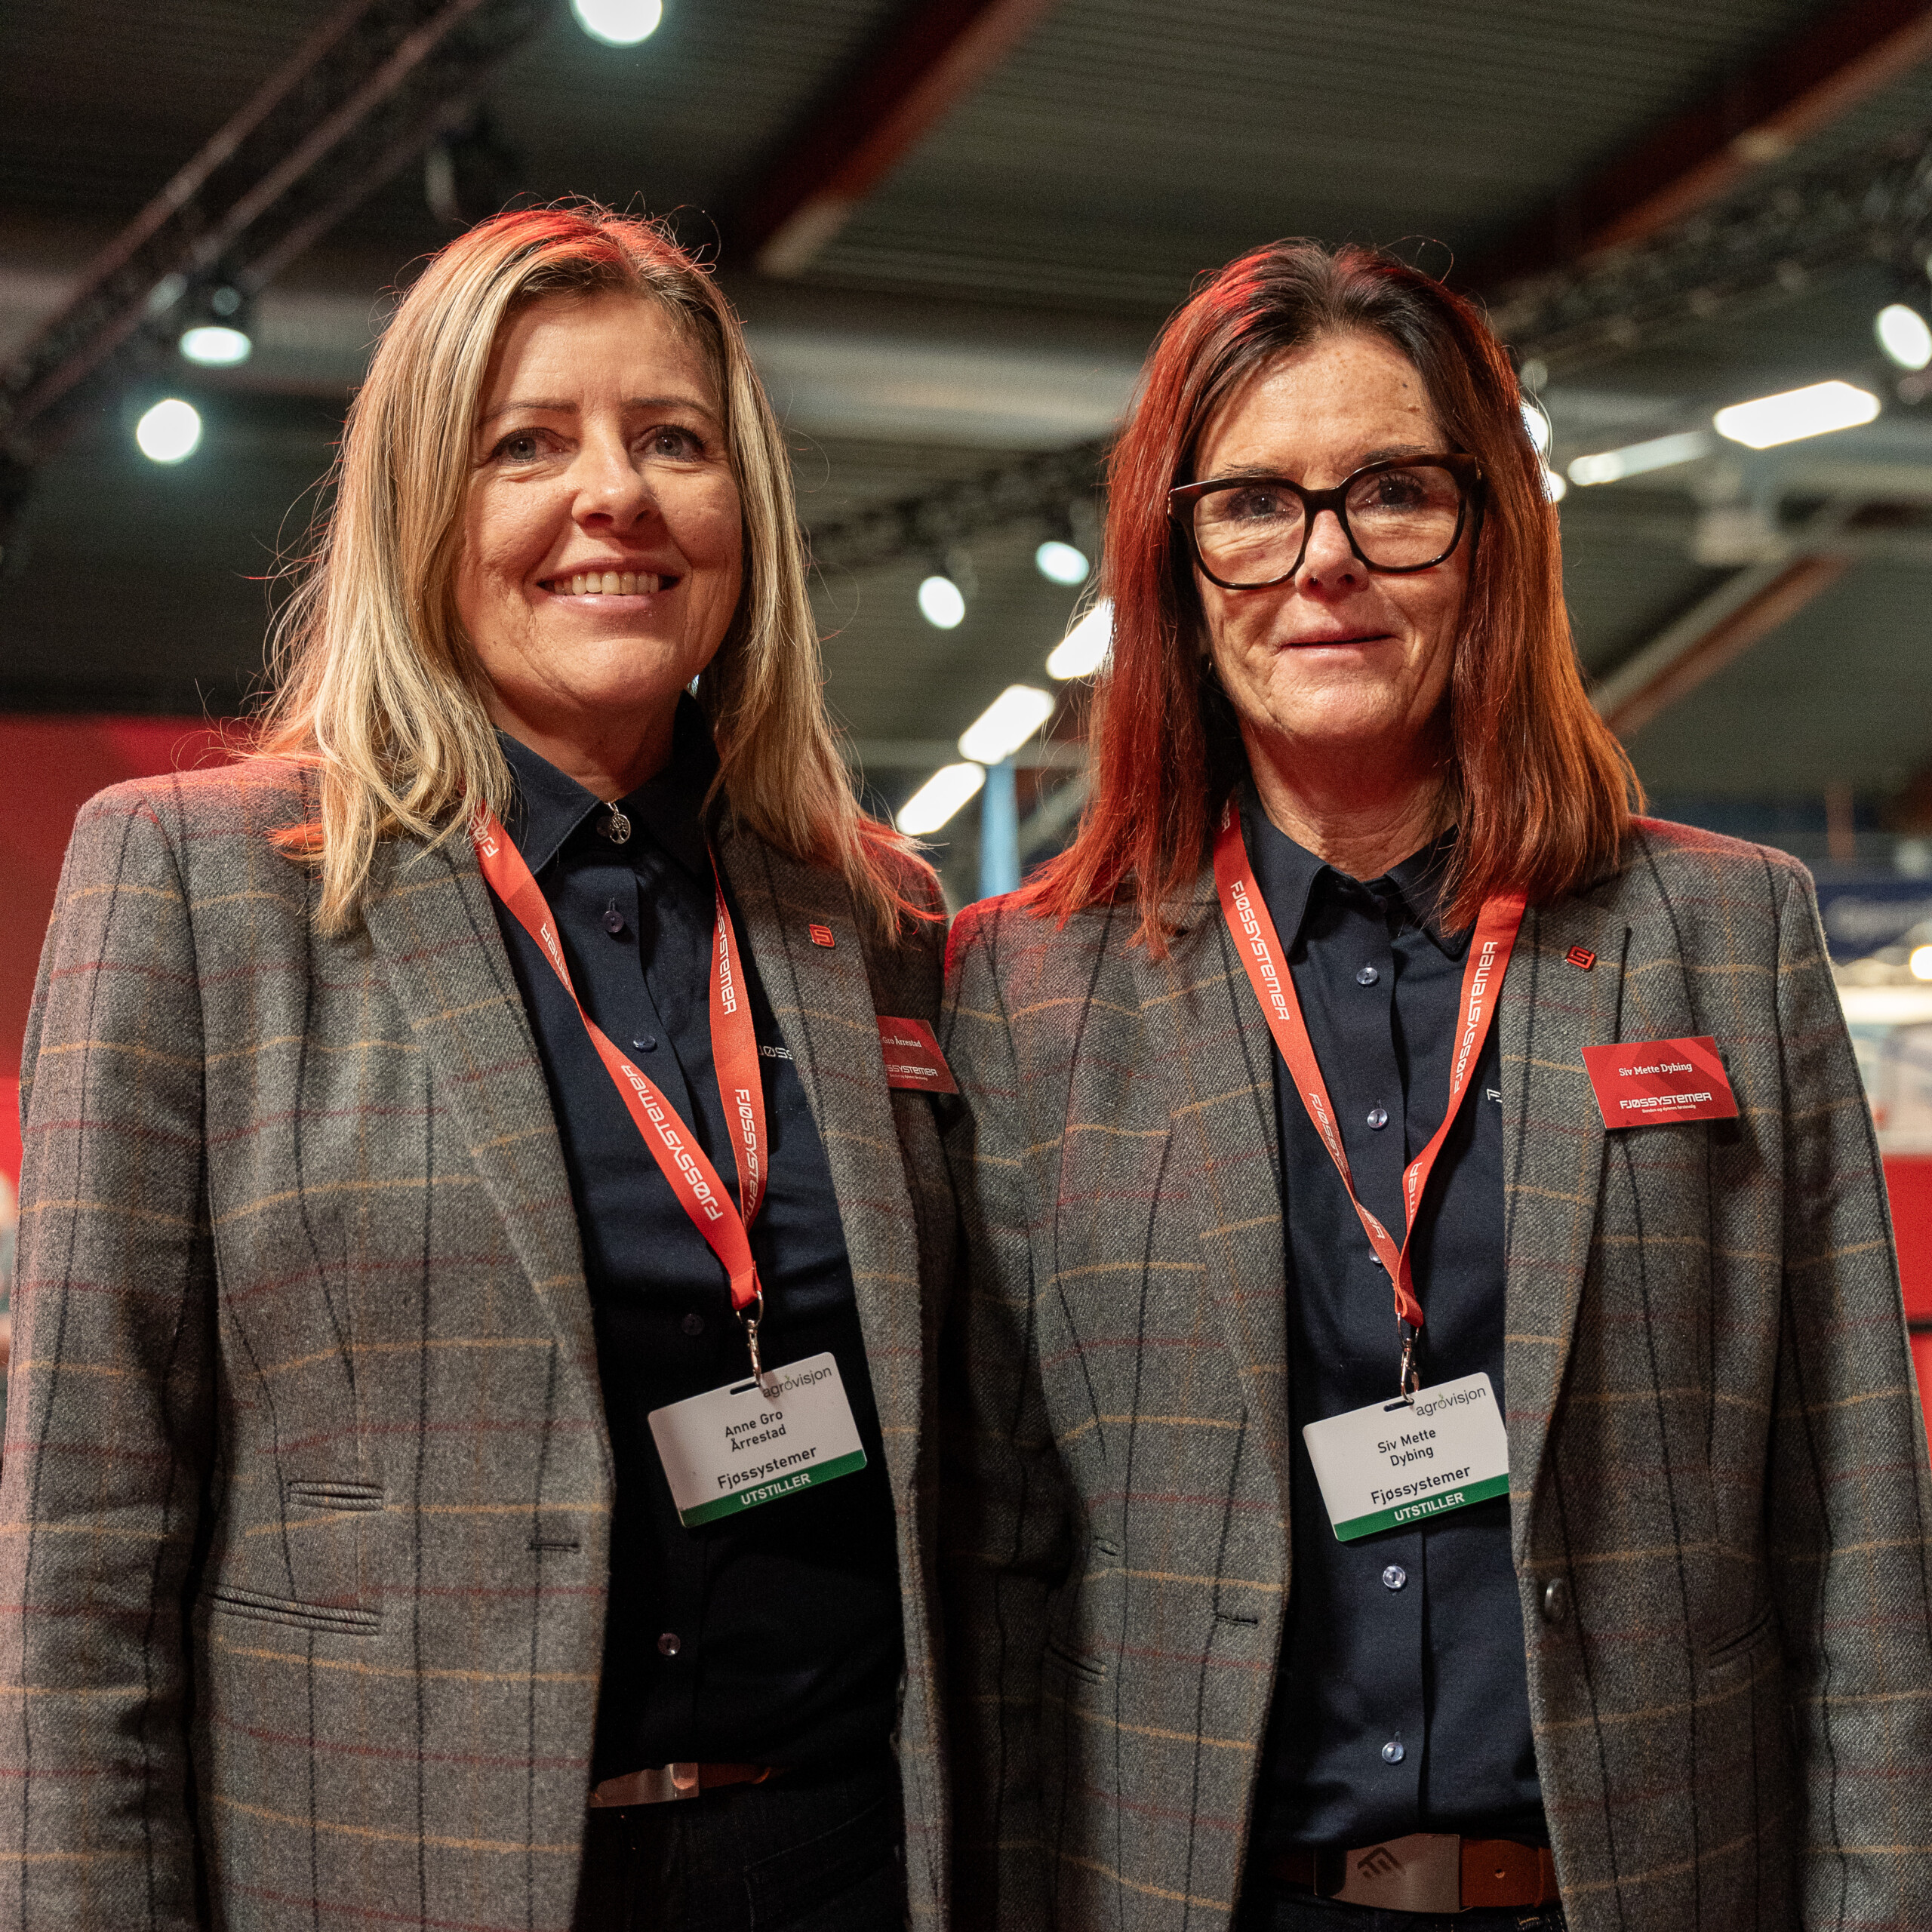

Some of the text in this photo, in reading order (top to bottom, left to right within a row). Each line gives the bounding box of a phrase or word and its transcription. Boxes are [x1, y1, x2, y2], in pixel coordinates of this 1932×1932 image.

[1618, 1063, 1693, 1077] Siv Mette Dybing
[762, 1367, 832, 1398] agrovisjon
[1416, 1386, 1487, 1417] agrovisjon
[724, 1411, 783, 1438] Anne Gro
[731, 1424, 786, 1452] Årrestad
[1377, 1429, 1437, 1454] Siv Mette
[1389, 1446, 1435, 1466] Dybing
[717, 1447, 818, 1490] Fjøssystemer
[740, 1472, 812, 1506] UTSTILLER
[1370, 1466, 1471, 1505] Fjøssystemer
[1394, 1491, 1466, 1522] UTSTILLER
